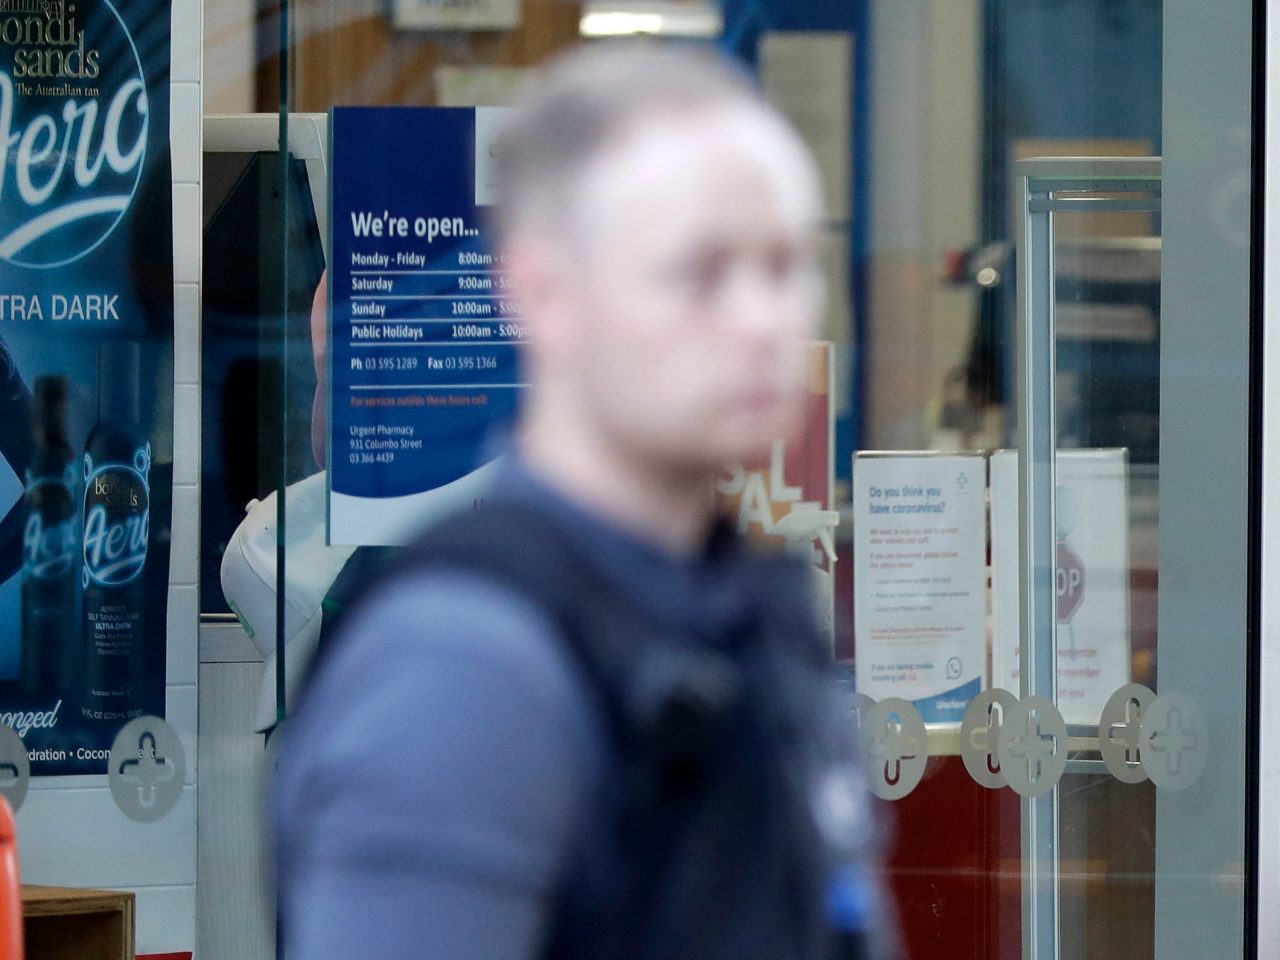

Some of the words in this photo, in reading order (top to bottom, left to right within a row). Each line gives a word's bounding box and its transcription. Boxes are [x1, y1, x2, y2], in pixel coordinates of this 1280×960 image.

[0, 0, 77, 46] ondi
[13, 29, 100, 78] sands
[17, 82, 33, 96] The
[35, 82, 82, 97] Australian
[84, 85, 100, 97] tan
[414, 217, 480, 243] open...
[351, 252, 390, 268] Monday
[396, 252, 426, 268] Friday
[458, 252, 492, 265] 8:00am
[351, 277, 394, 293] Saturday
[458, 276, 492, 289] 9:00am
[51, 295, 120, 320] DARK
[351, 302, 386, 318] Sunday
[451, 301, 491, 314] 10:00am
[351, 325, 381, 339] Public
[382, 324, 424, 341] Holidays
[451, 325, 491, 337] 10:00am
[350, 357, 363, 370] Ph
[365, 358, 376, 370] 03
[396, 357, 418, 370] 1289
[427, 357, 443, 369] Fax
[445, 357, 456, 369] 03
[475, 356, 497, 369] 1366
[350, 425, 376, 438] Urgent
[377, 424, 414, 437] Pharmacy
[364, 439, 399, 450] Columbo
[400, 438, 422, 449] Street
[1057, 568, 1080, 597] OP
[0, 699, 62, 738] onzed
[76, 747, 112, 760] Cocon
